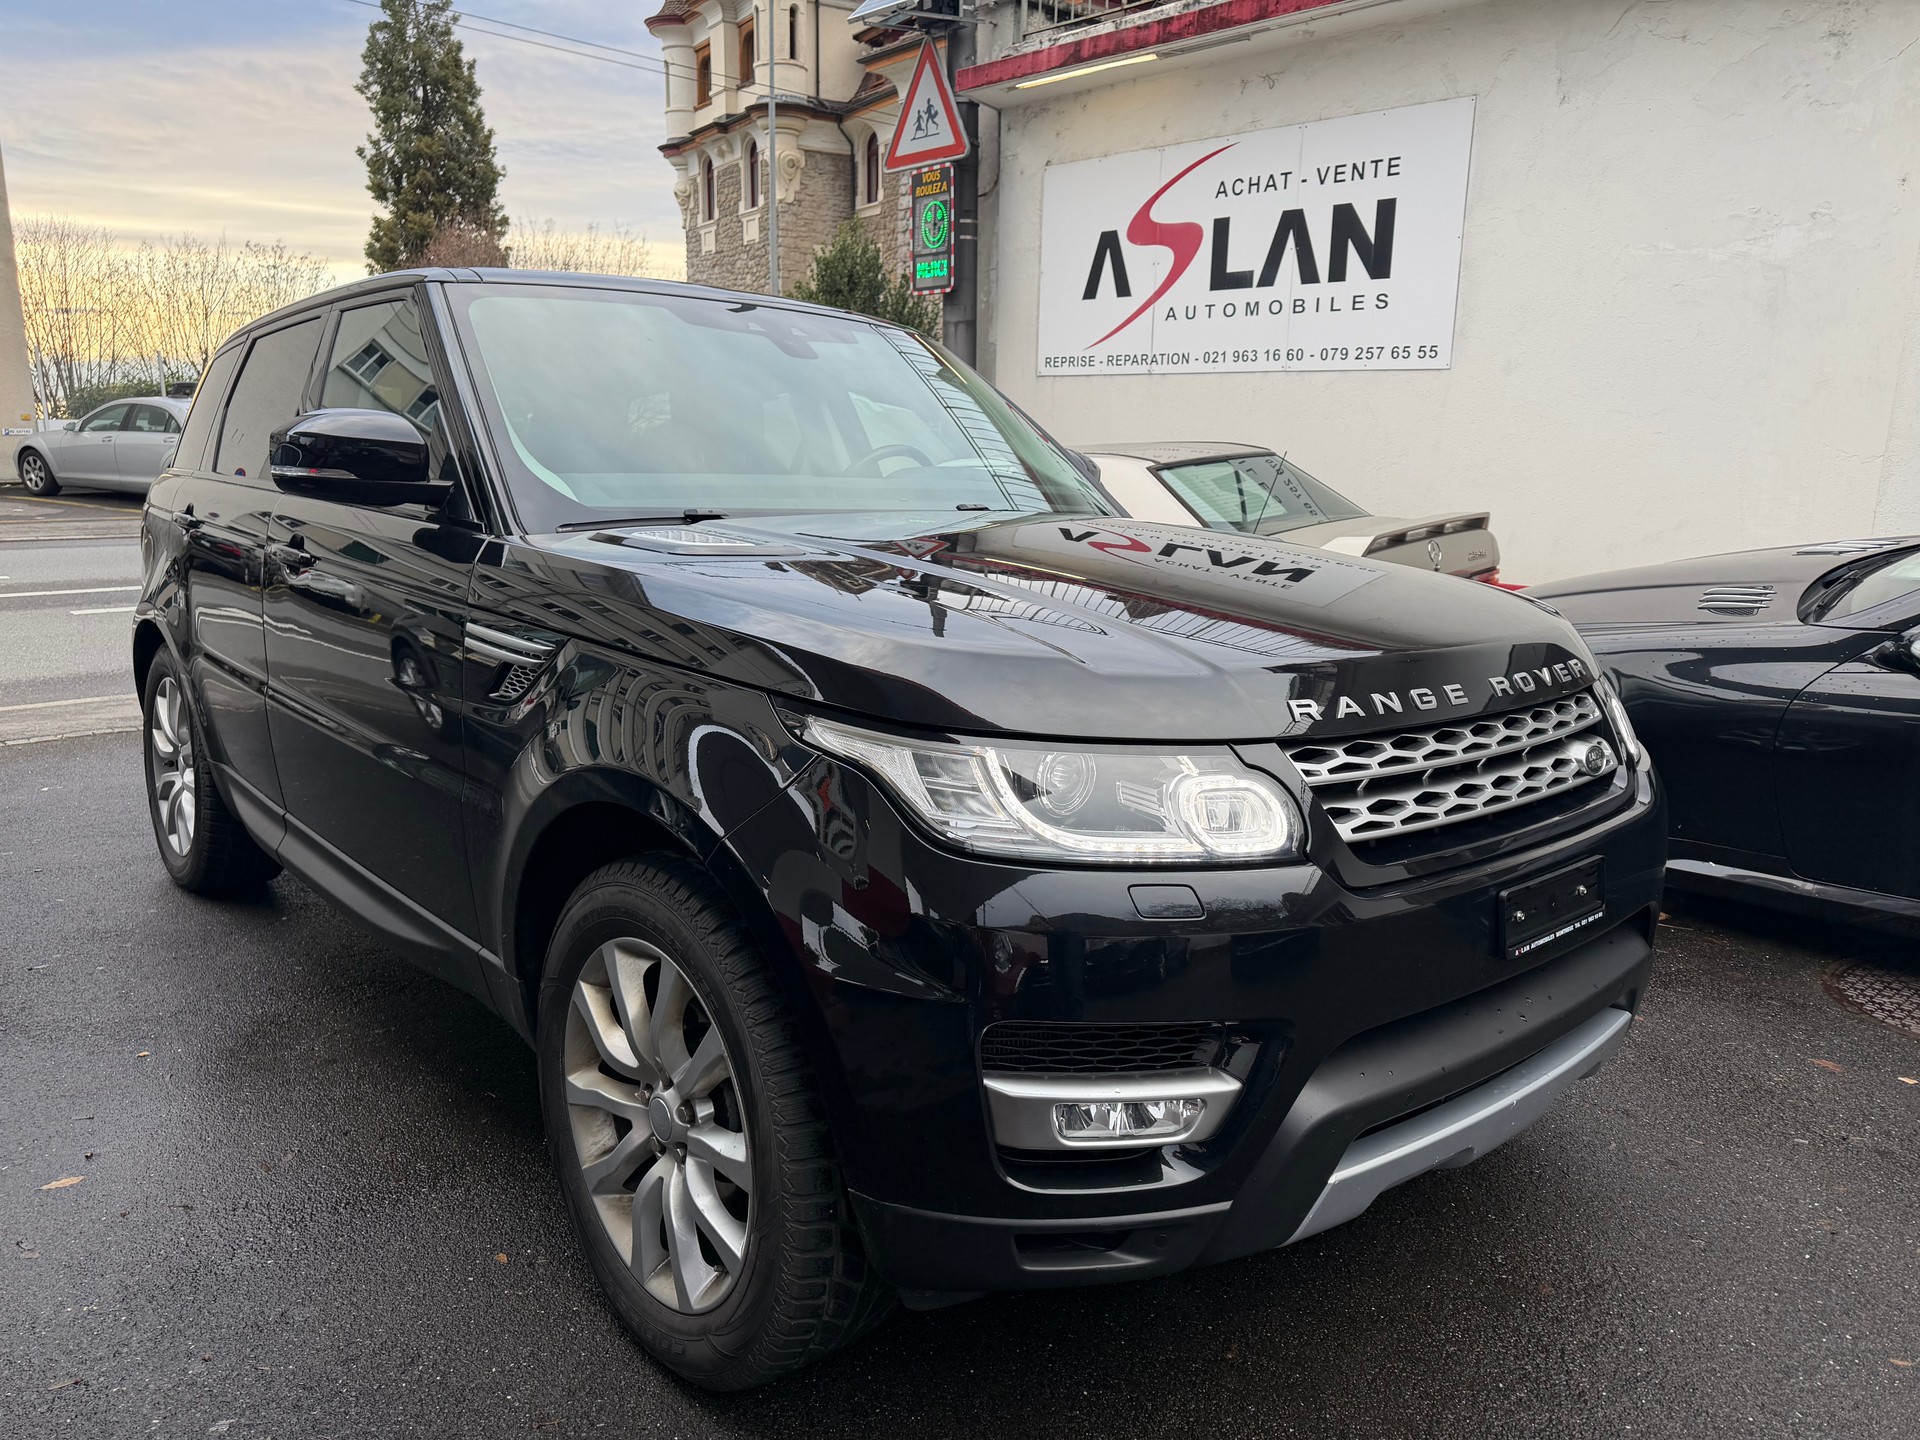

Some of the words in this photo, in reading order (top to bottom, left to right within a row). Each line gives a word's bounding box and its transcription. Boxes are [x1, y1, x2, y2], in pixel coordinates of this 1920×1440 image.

[915, 182, 941, 198] ROULEZ
[922, 170, 941, 183] VOUS
[1215, 171, 1293, 199] ACHAT
[1316, 156, 1401, 185] VENTE
[1082, 142, 1397, 350] ASLAN
[1165, 293, 1390, 321] AUTOMOBILES
[1045, 355, 1096, 368] REPRISE
[1106, 353, 1191, 367] REPARATION
[1203, 350, 1227, 364] 021
[1232, 349, 1258, 363] 963
[1264, 349, 1281, 362] 16
[1286, 348, 1304, 361] 60
[1320, 347, 1349, 361] 079
[1354, 346, 1385, 360] 257
[1391, 346, 1411, 359] 65
[1417, 345, 1439, 359] 55
[1287, 684, 1469, 722] RANGE
[1488, 659, 1587, 698] ROVER
